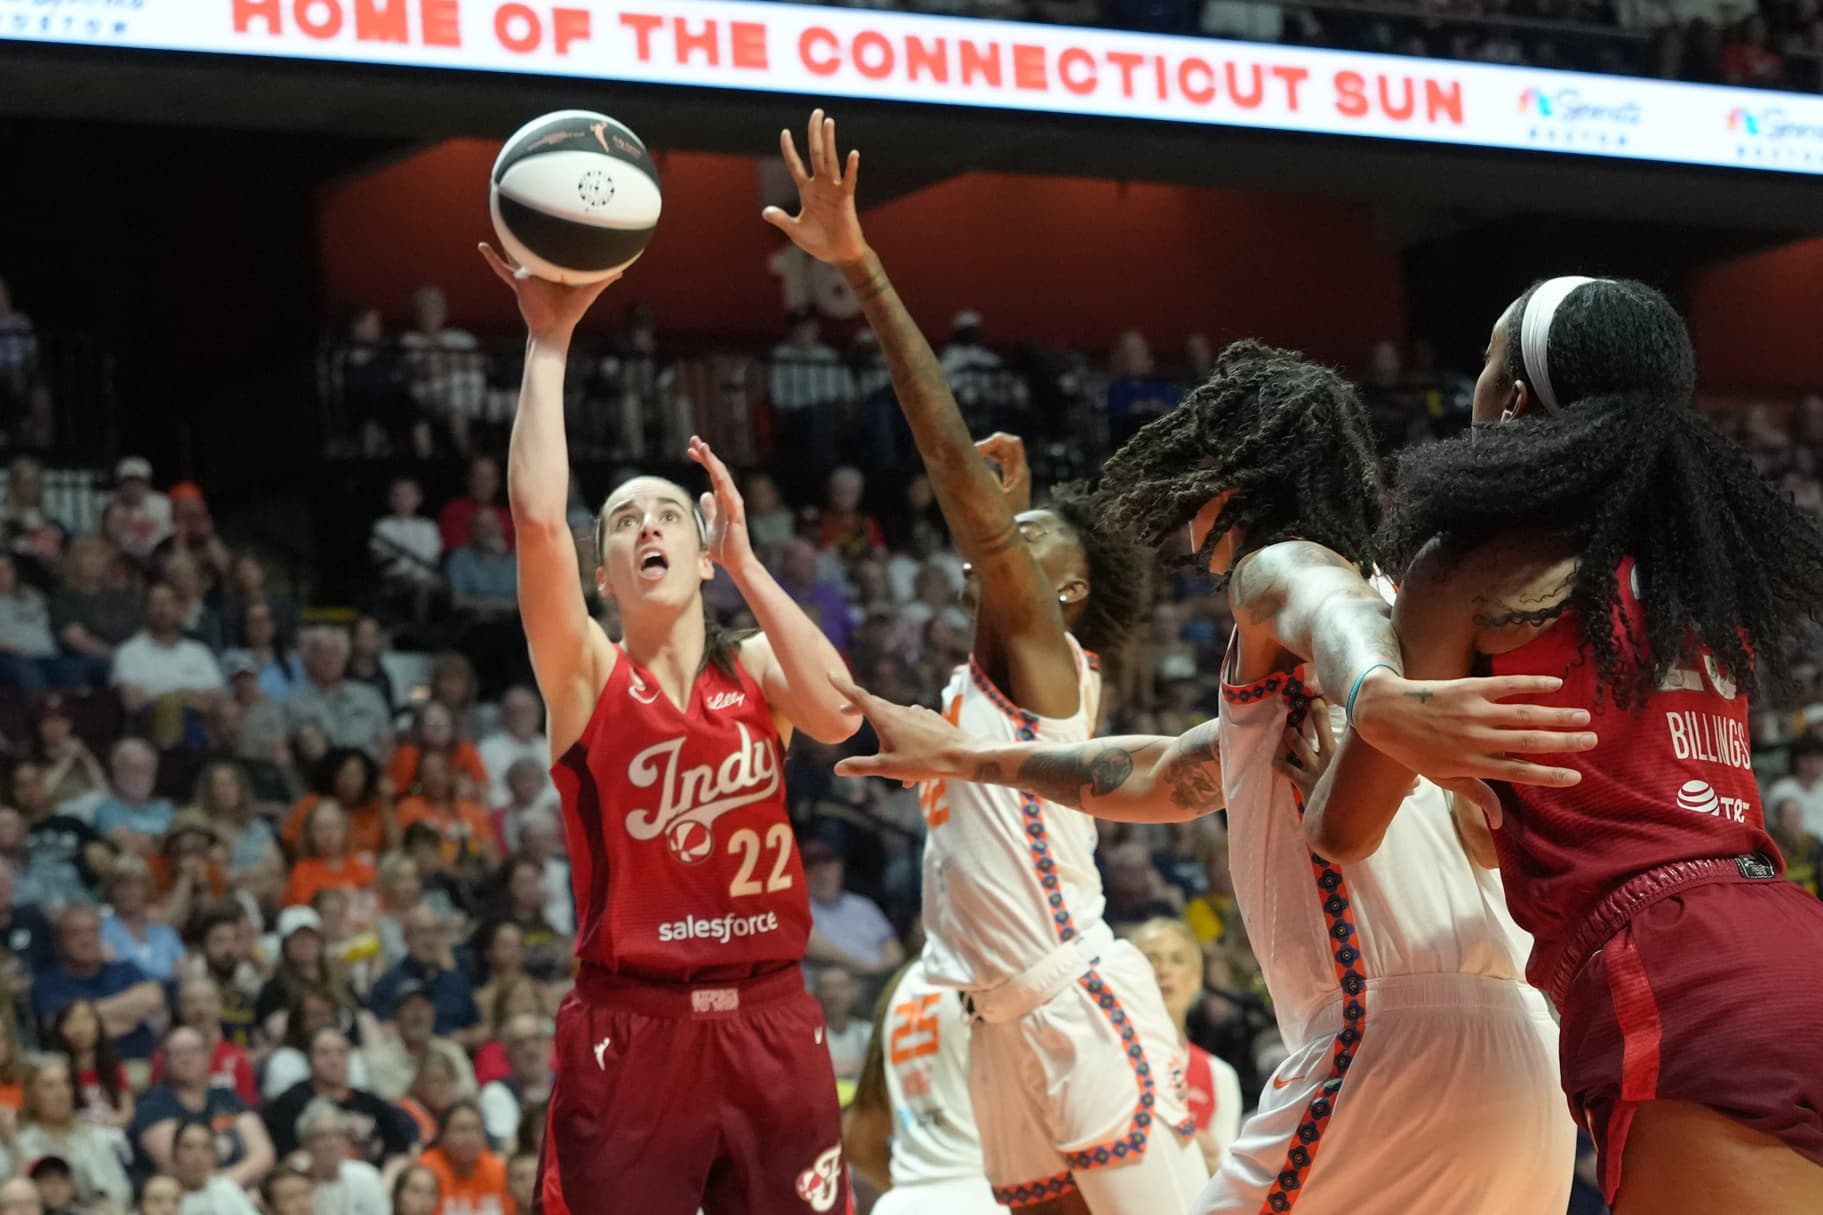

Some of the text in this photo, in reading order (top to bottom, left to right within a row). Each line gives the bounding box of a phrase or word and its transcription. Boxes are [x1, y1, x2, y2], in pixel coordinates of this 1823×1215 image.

[233, 0, 1464, 126] HOME OF THE CONNECTICUT SUN
[1666, 711, 1751, 770] BILLINGS
[626, 721, 780, 841] Indy
[728, 823, 793, 898] 22
[658, 911, 778, 944] salesforce
